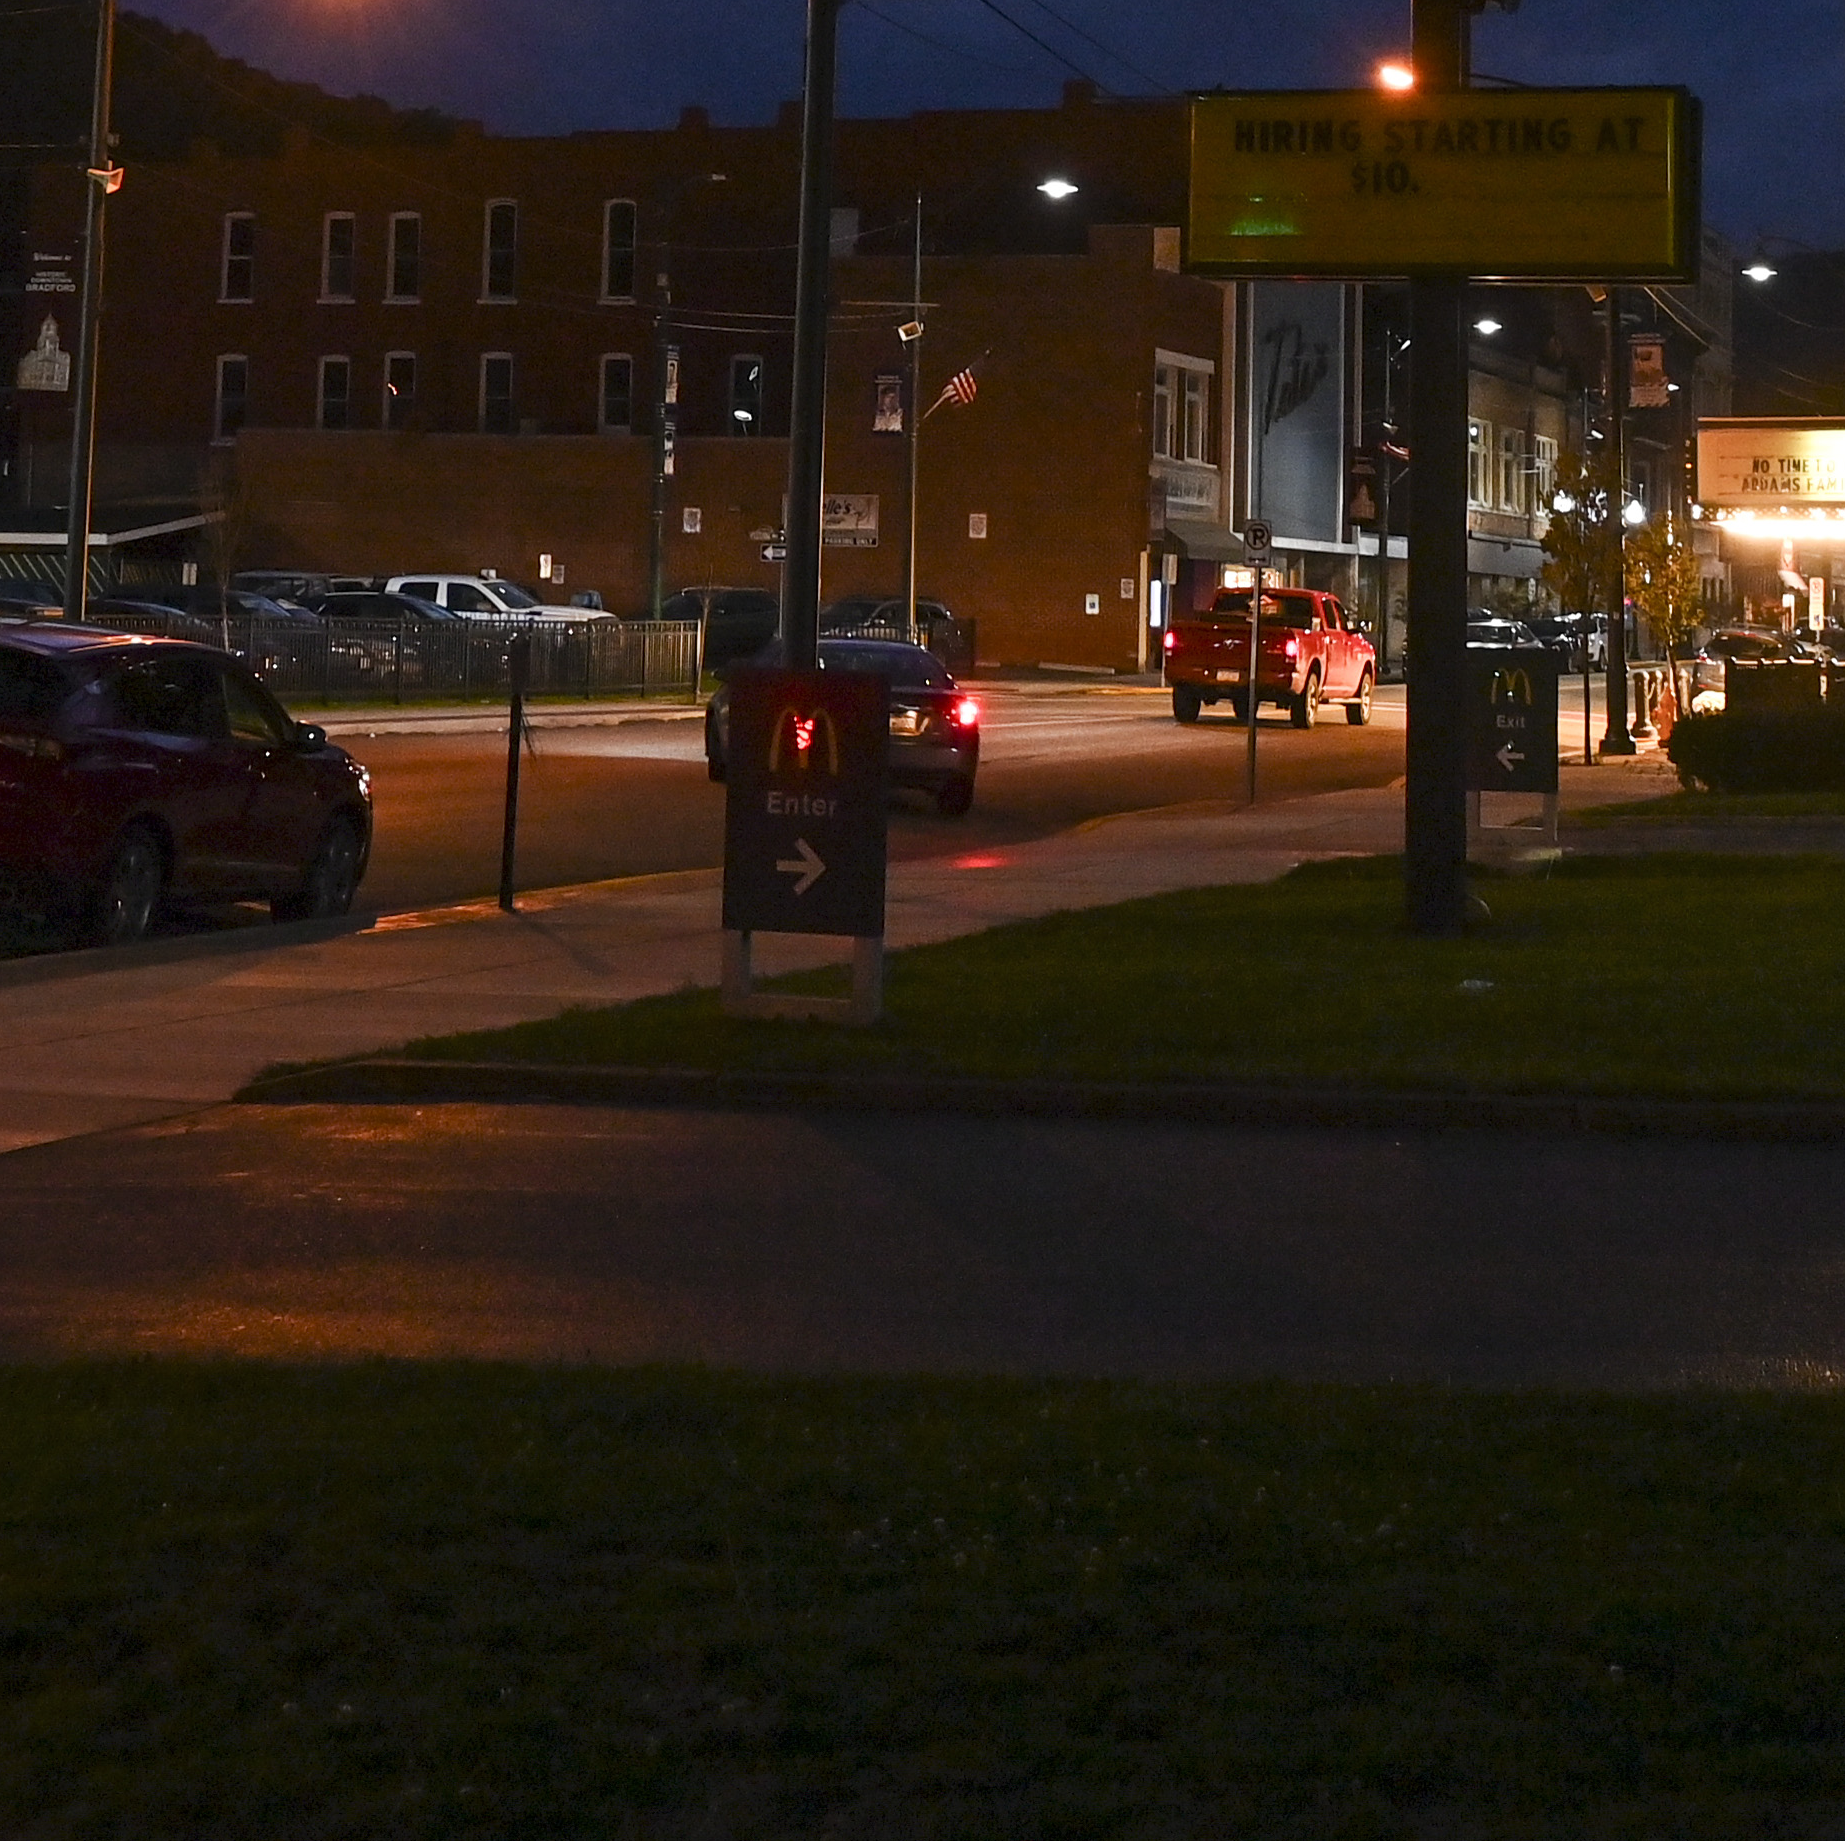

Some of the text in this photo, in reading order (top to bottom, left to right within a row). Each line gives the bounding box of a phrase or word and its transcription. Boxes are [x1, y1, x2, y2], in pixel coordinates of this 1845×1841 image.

[1235, 116, 1645, 153] HIRING STARTING AT
[1751, 459, 1770, 474] NO
[1777, 458, 1809, 473] TIME
[1496, 714, 1526, 729] Exit
[765, 791, 839, 818] Enter
